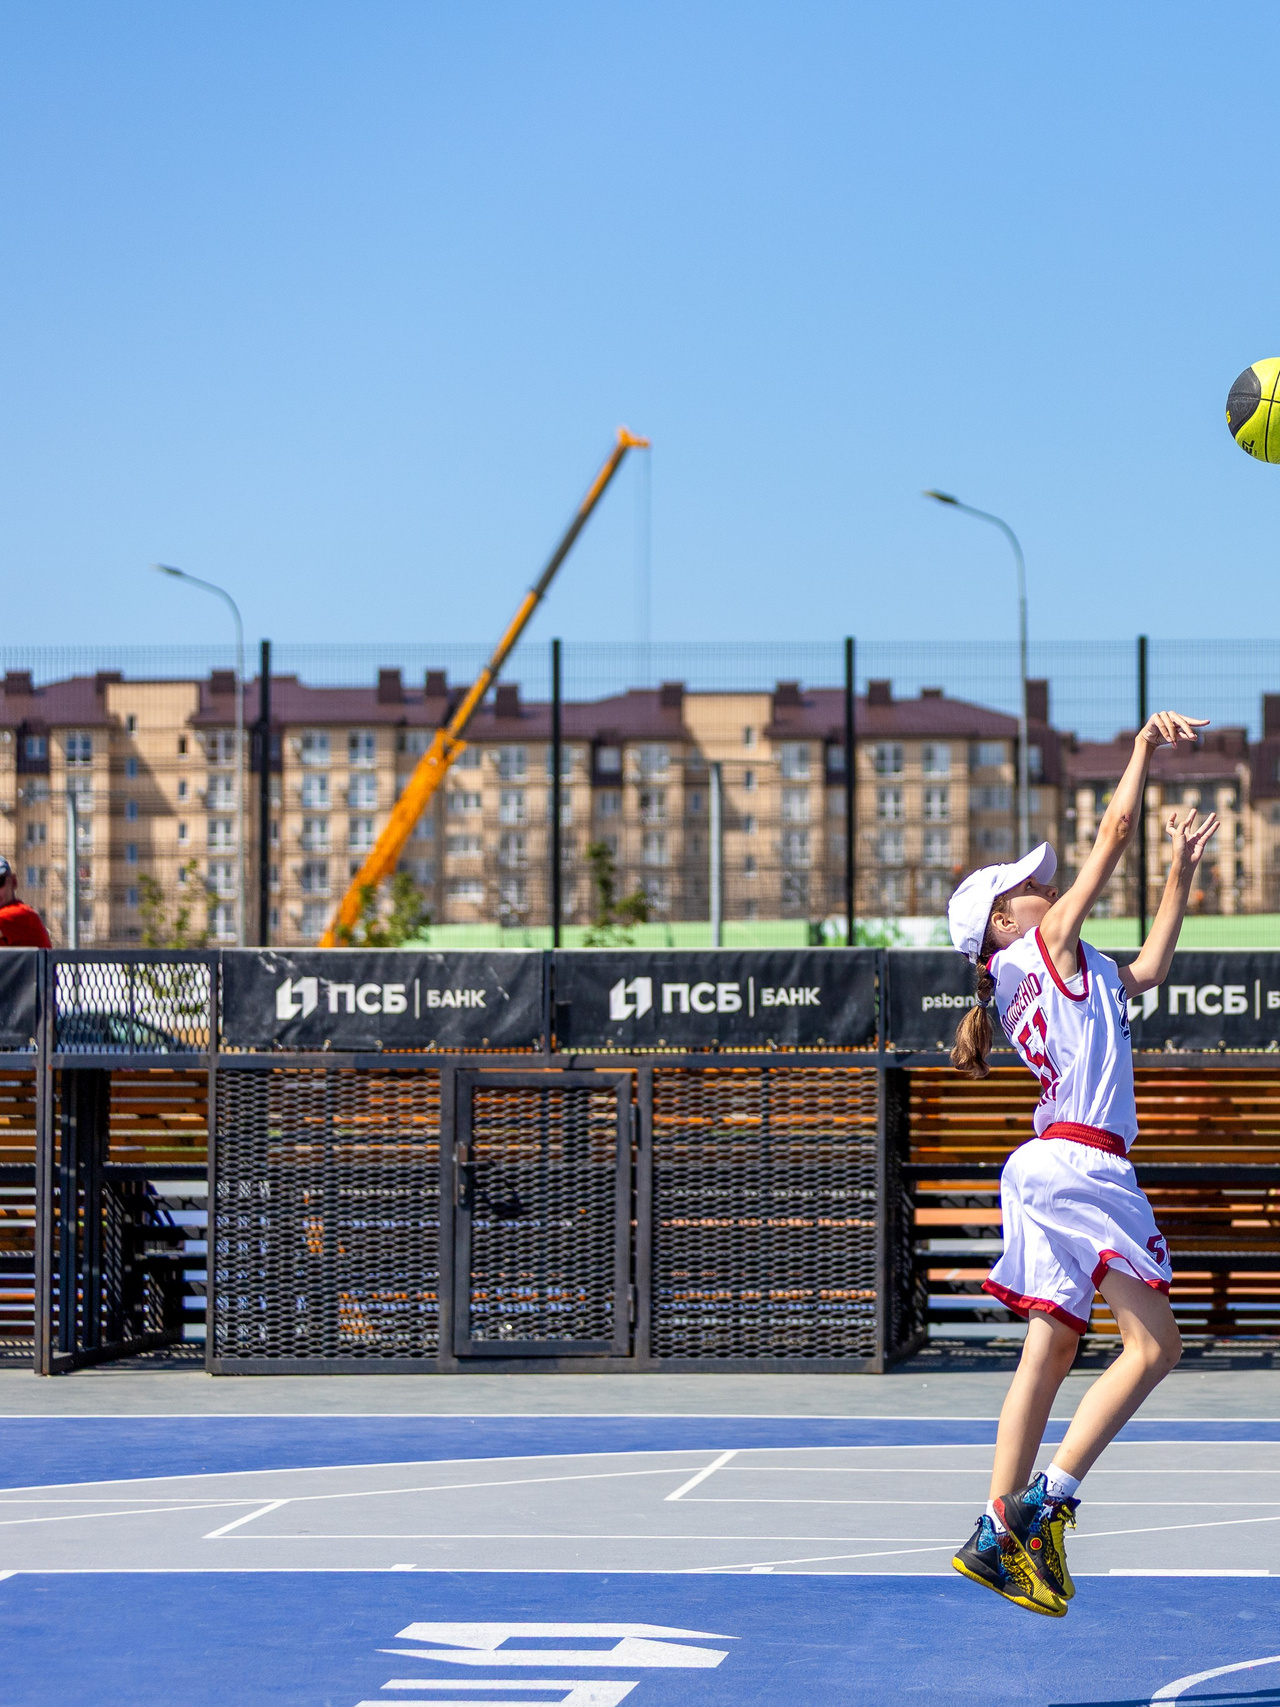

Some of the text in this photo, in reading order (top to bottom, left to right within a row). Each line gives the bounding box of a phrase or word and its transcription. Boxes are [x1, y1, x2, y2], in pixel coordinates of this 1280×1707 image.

[327, 982, 487, 1015] ПСБ БАНК
[661, 981, 822, 1014] ПСБ БАНК
[1167, 984, 1249, 1016] ПСБ
